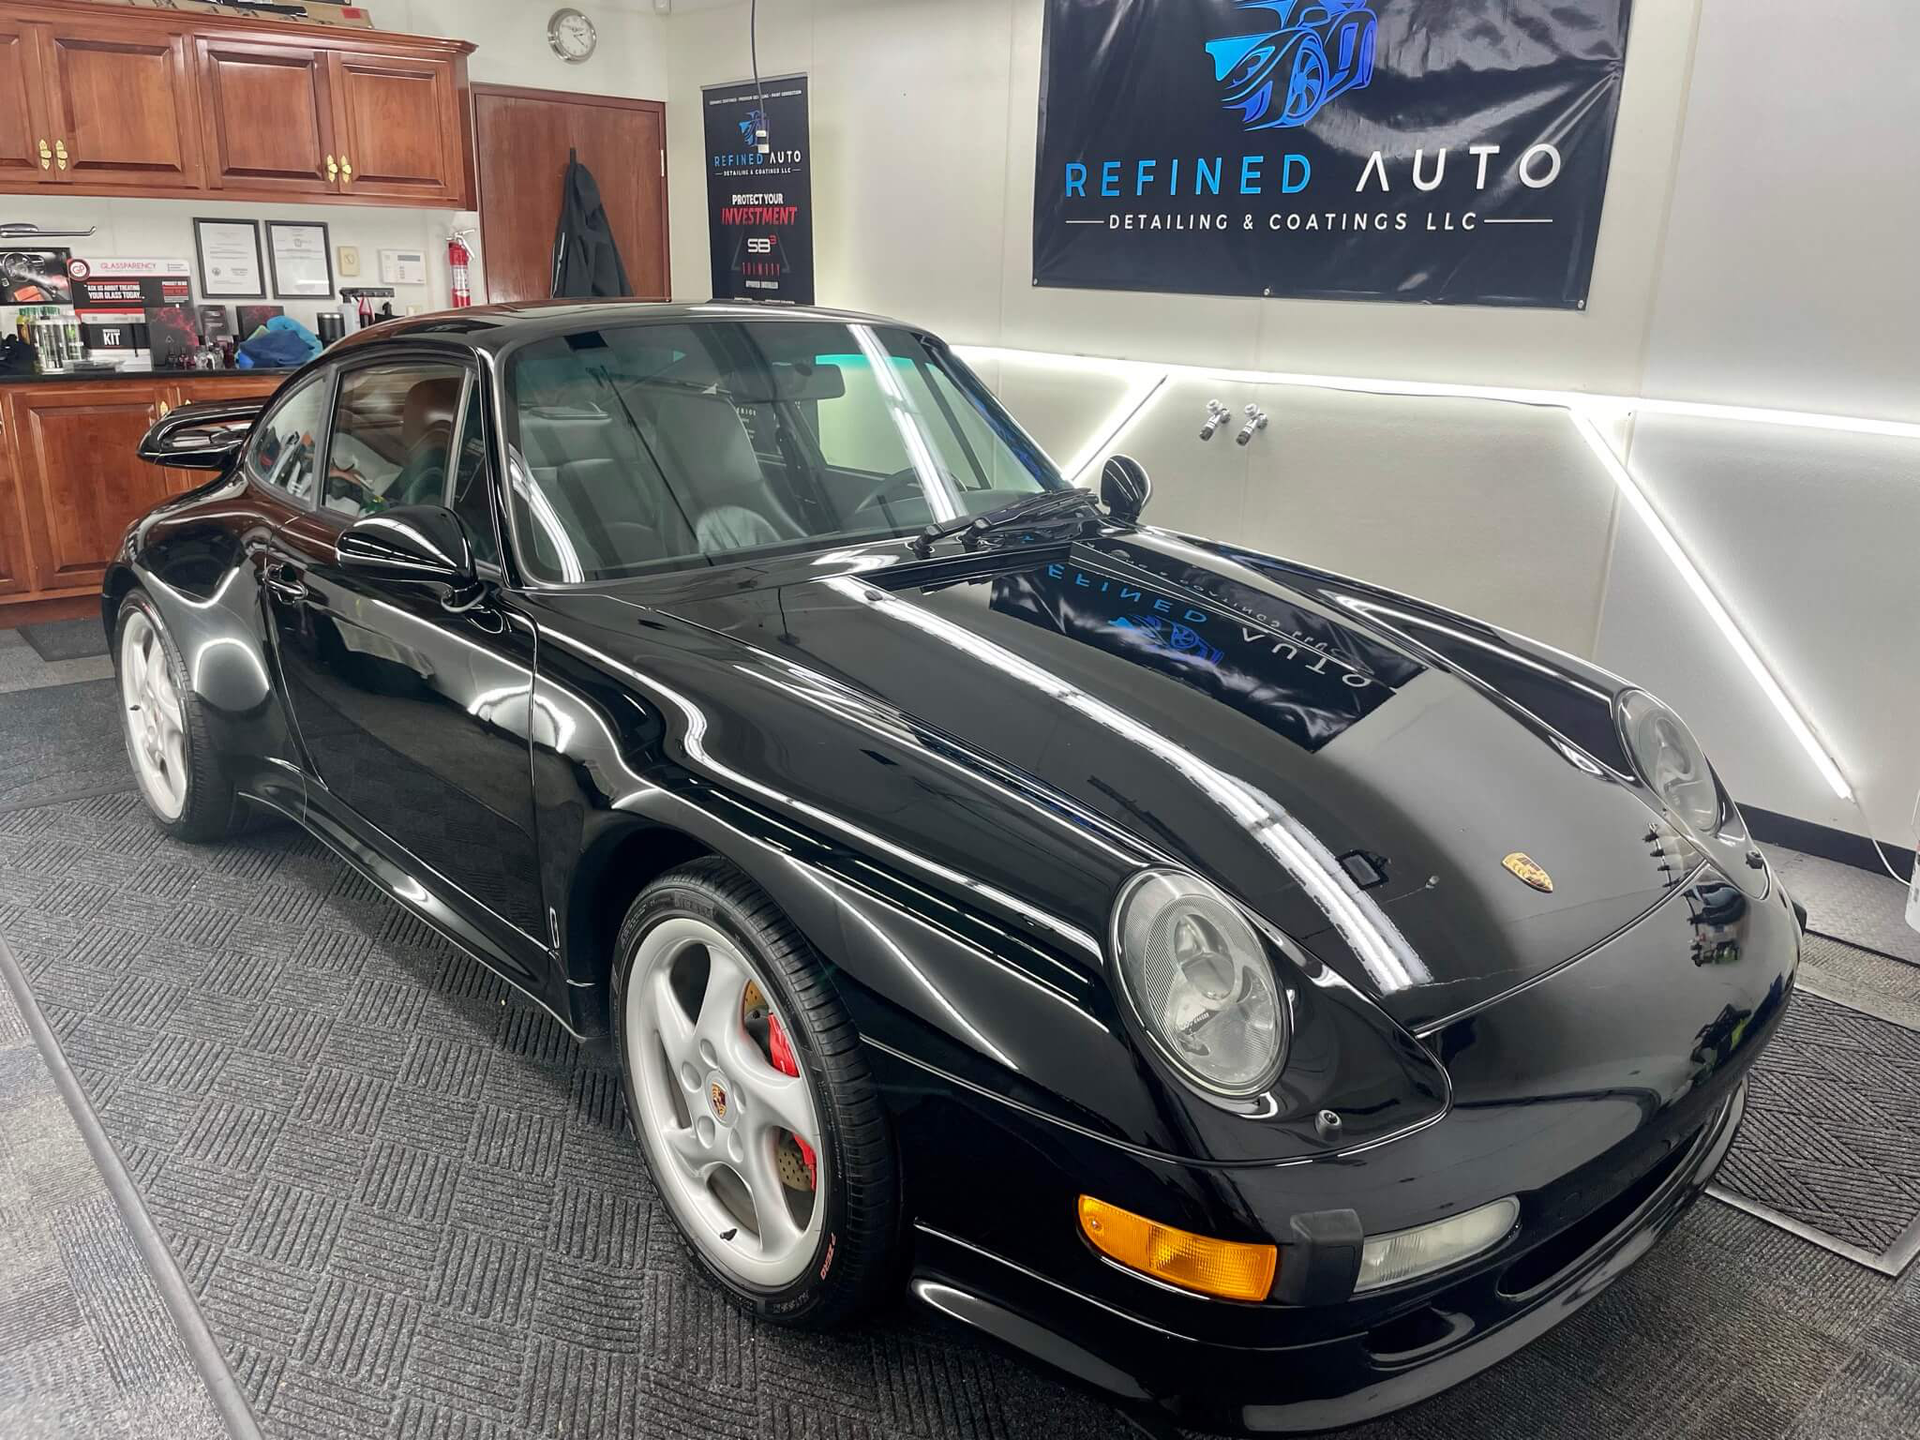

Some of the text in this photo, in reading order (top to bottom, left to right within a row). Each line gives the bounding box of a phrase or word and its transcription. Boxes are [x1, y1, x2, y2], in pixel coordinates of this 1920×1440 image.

[714, 150, 801, 167] REFINED AUTO
[1065, 143, 1562, 199] REFINED AUTO
[732, 193, 784, 206] PROTECT YOUR
[722, 206, 797, 226] INVESTMENT
[1108, 212, 1478, 231] DETAILING & COATINGS LLC
[100, 262, 157, 271] GLASSPARENCY
[88, 291, 104, 300] YOUR
[104, 291, 122, 299] GLASS
[103, 333, 120, 346] KIT
